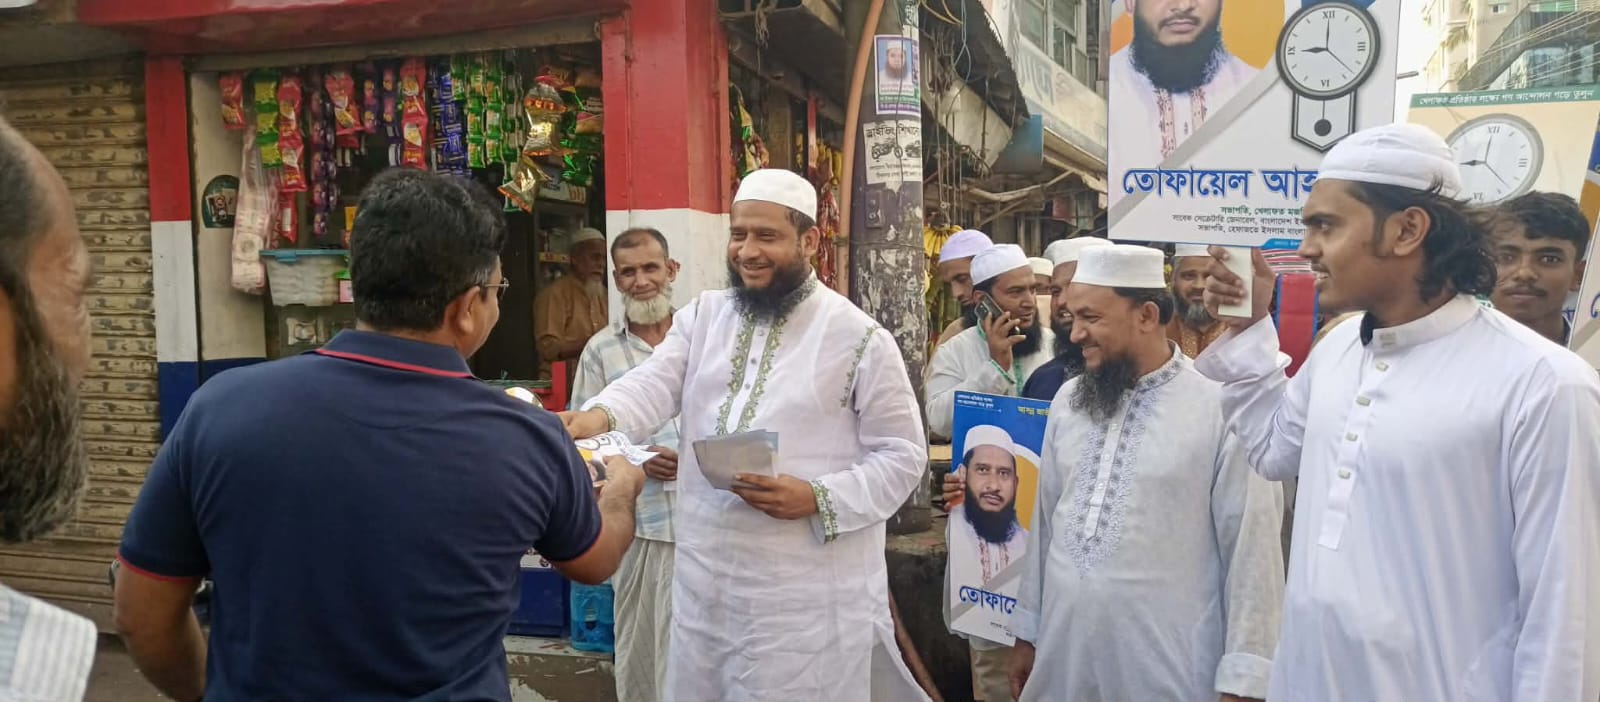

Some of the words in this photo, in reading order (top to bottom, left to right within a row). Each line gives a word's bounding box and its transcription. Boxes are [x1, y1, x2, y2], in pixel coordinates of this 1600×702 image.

[1322, 10, 1335, 20] XII
[1123, 166, 1254, 198] তোফায়েল
[1261, 166, 1319, 199] আহ
